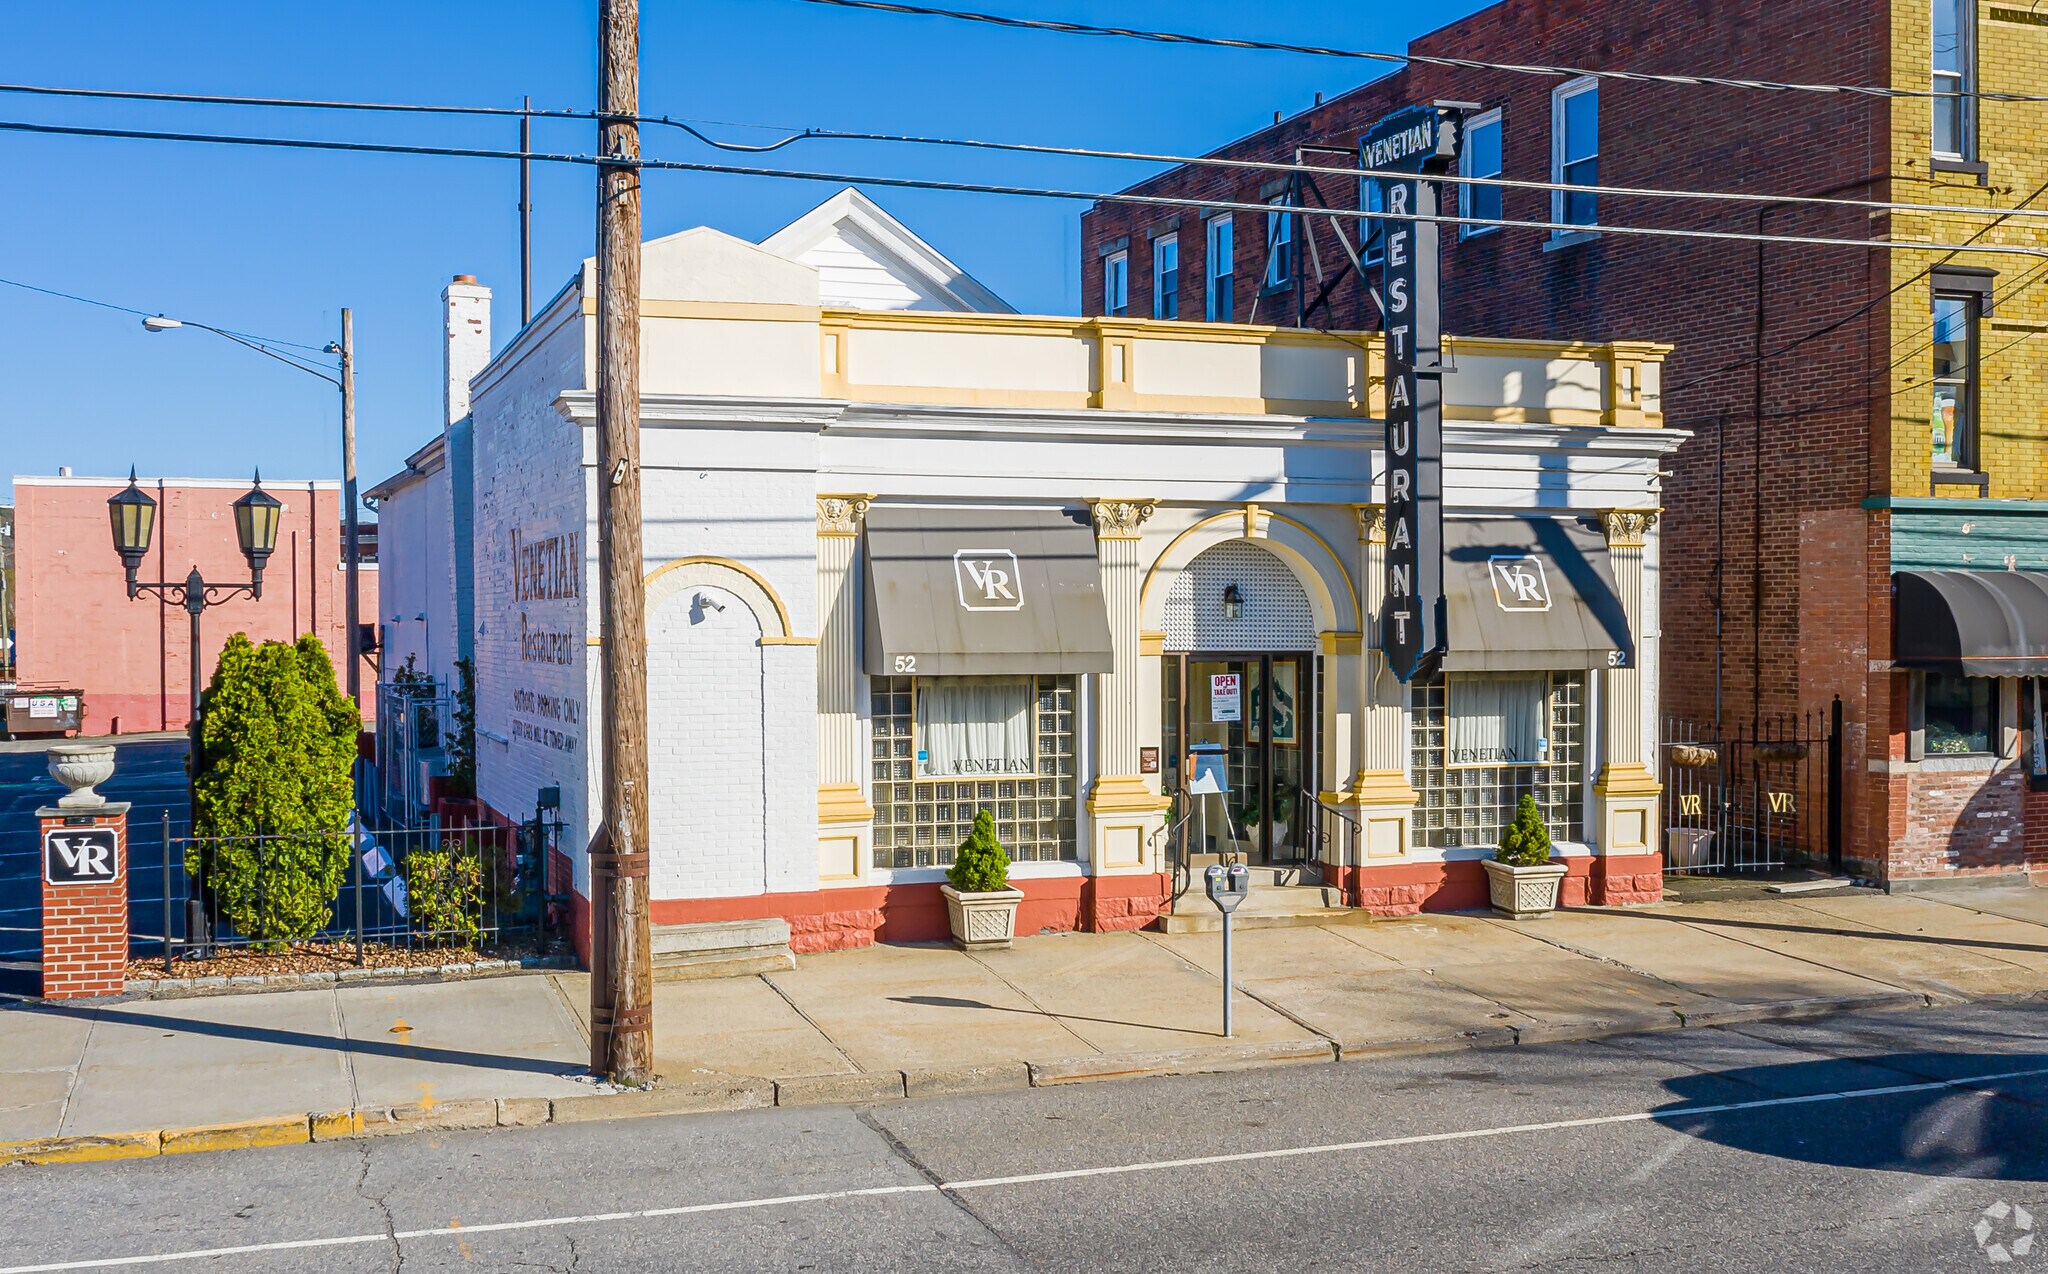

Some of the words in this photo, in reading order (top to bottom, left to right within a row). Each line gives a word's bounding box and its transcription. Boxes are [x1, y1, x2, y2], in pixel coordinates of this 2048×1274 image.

[1363, 118, 1431, 168] VENETIAN
[1387, 183, 1411, 645] RESTAURANT
[511, 528, 579, 602] VENETIAN
[961, 560, 1016, 599] VR
[1495, 565, 1545, 601] VR
[522, 612, 573, 665] Restaurant
[894, 655, 916, 673] 52
[1607, 650, 1626, 666] 52
[1214, 675, 1236, 687] OPEN
[563, 697, 580, 725] ONLY
[953, 758, 1029, 773] VENETIAN
[1451, 747, 1517, 762] VENETIAN
[1680, 794, 1702, 816] VR
[1768, 792, 1796, 813] VR
[50, 837, 113, 876] VR
